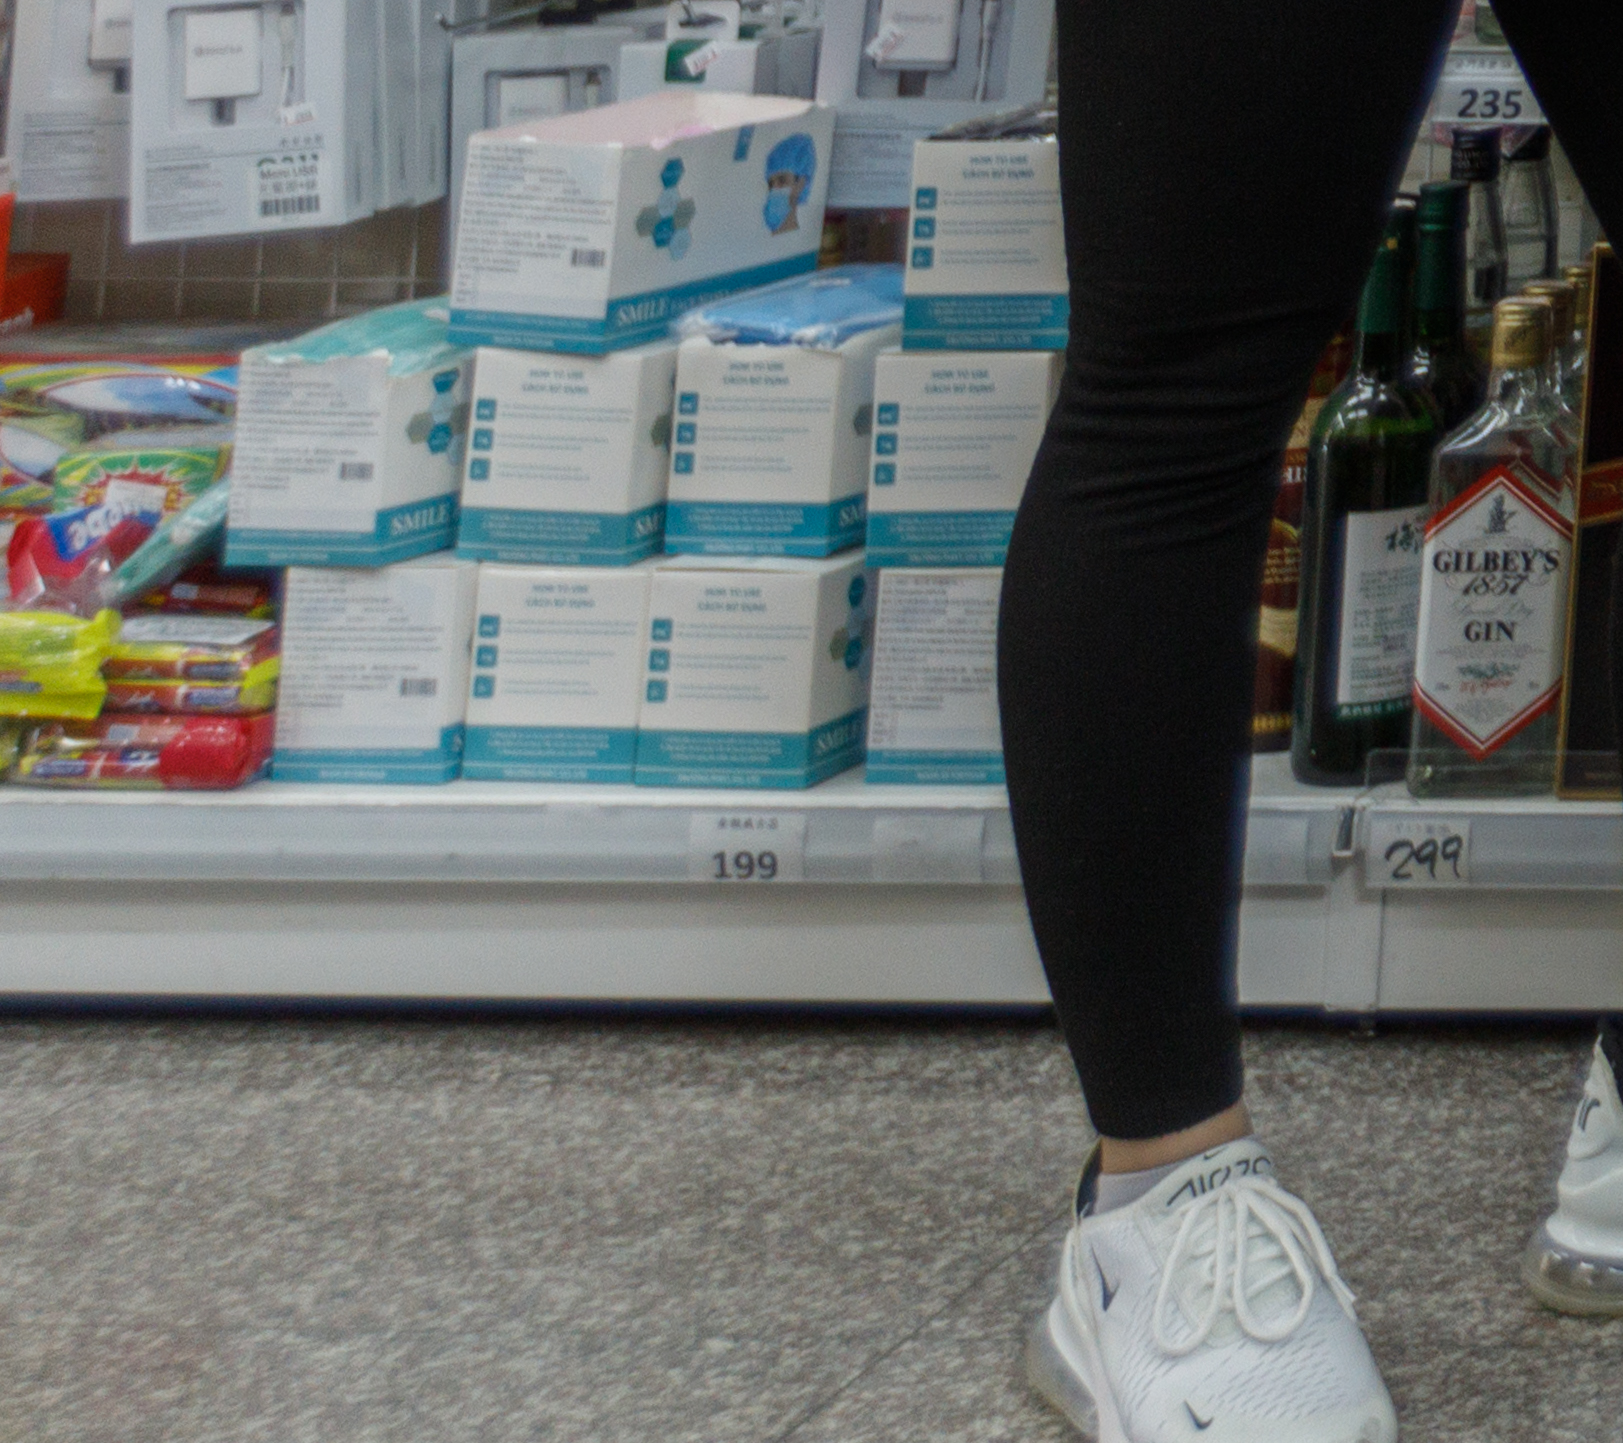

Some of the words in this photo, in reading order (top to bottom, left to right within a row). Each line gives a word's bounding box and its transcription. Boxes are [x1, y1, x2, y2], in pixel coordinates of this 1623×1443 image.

[1456, 87, 1523, 120] 235
[1432, 548, 1560, 575] GILBEY'S
[1460, 573, 1529, 597] 1857
[1463, 620, 1518, 644] GIN
[712, 850, 779, 881] 199
[1383, 833, 1464, 880] 299
